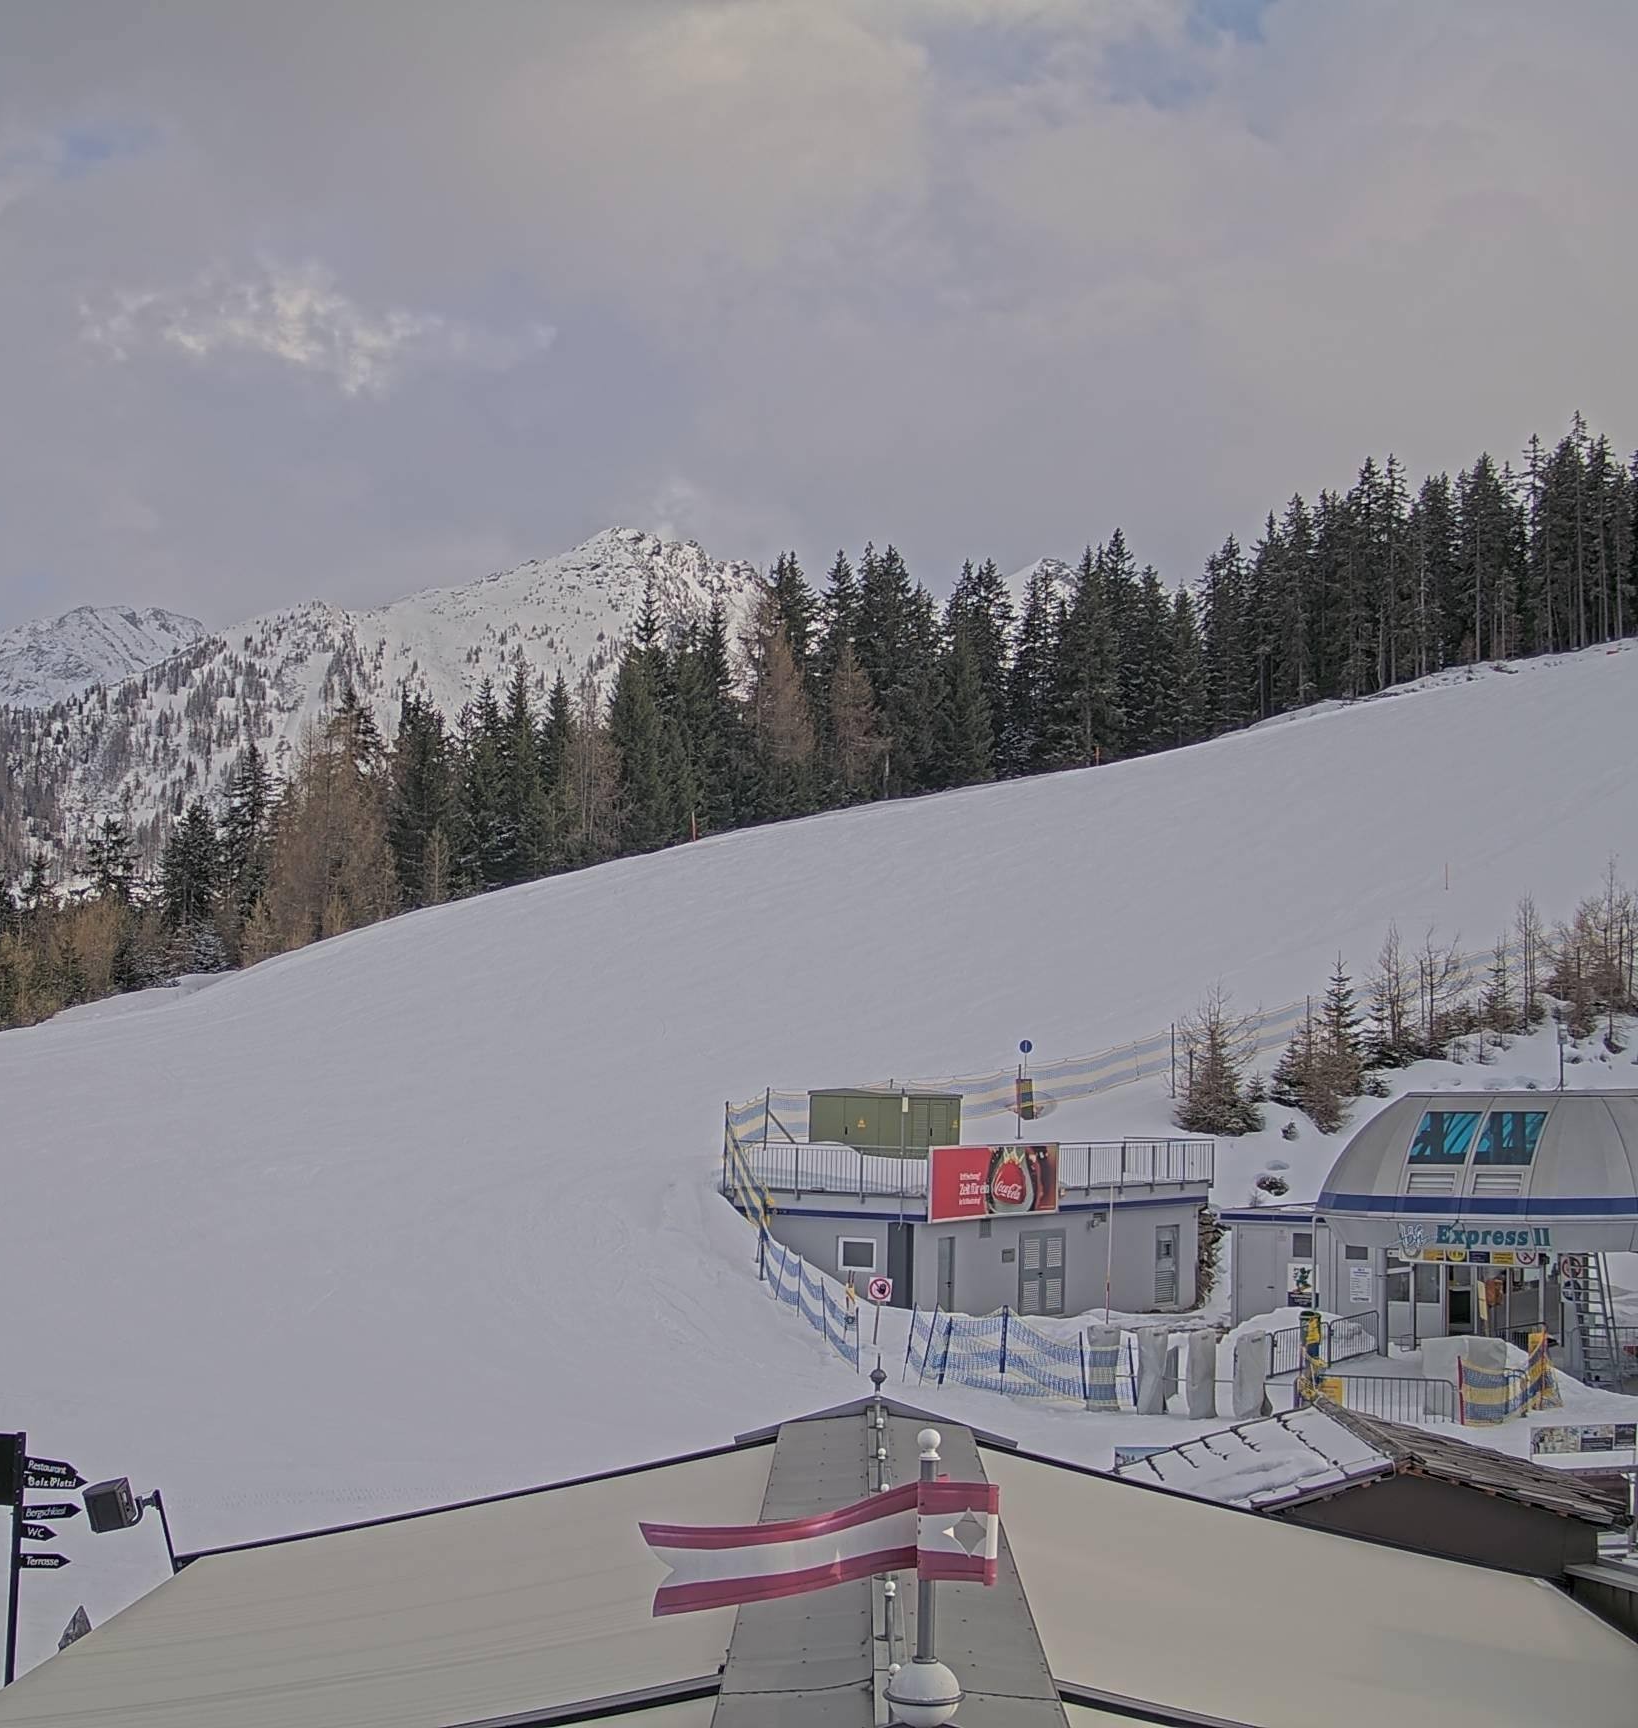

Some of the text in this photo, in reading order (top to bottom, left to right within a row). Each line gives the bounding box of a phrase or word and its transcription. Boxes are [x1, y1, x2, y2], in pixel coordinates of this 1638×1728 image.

[1436, 1225, 1528, 1249] Express
[27, 1526, 45, 1538] WC
[25, 1555, 60, 1567] Terrasse
